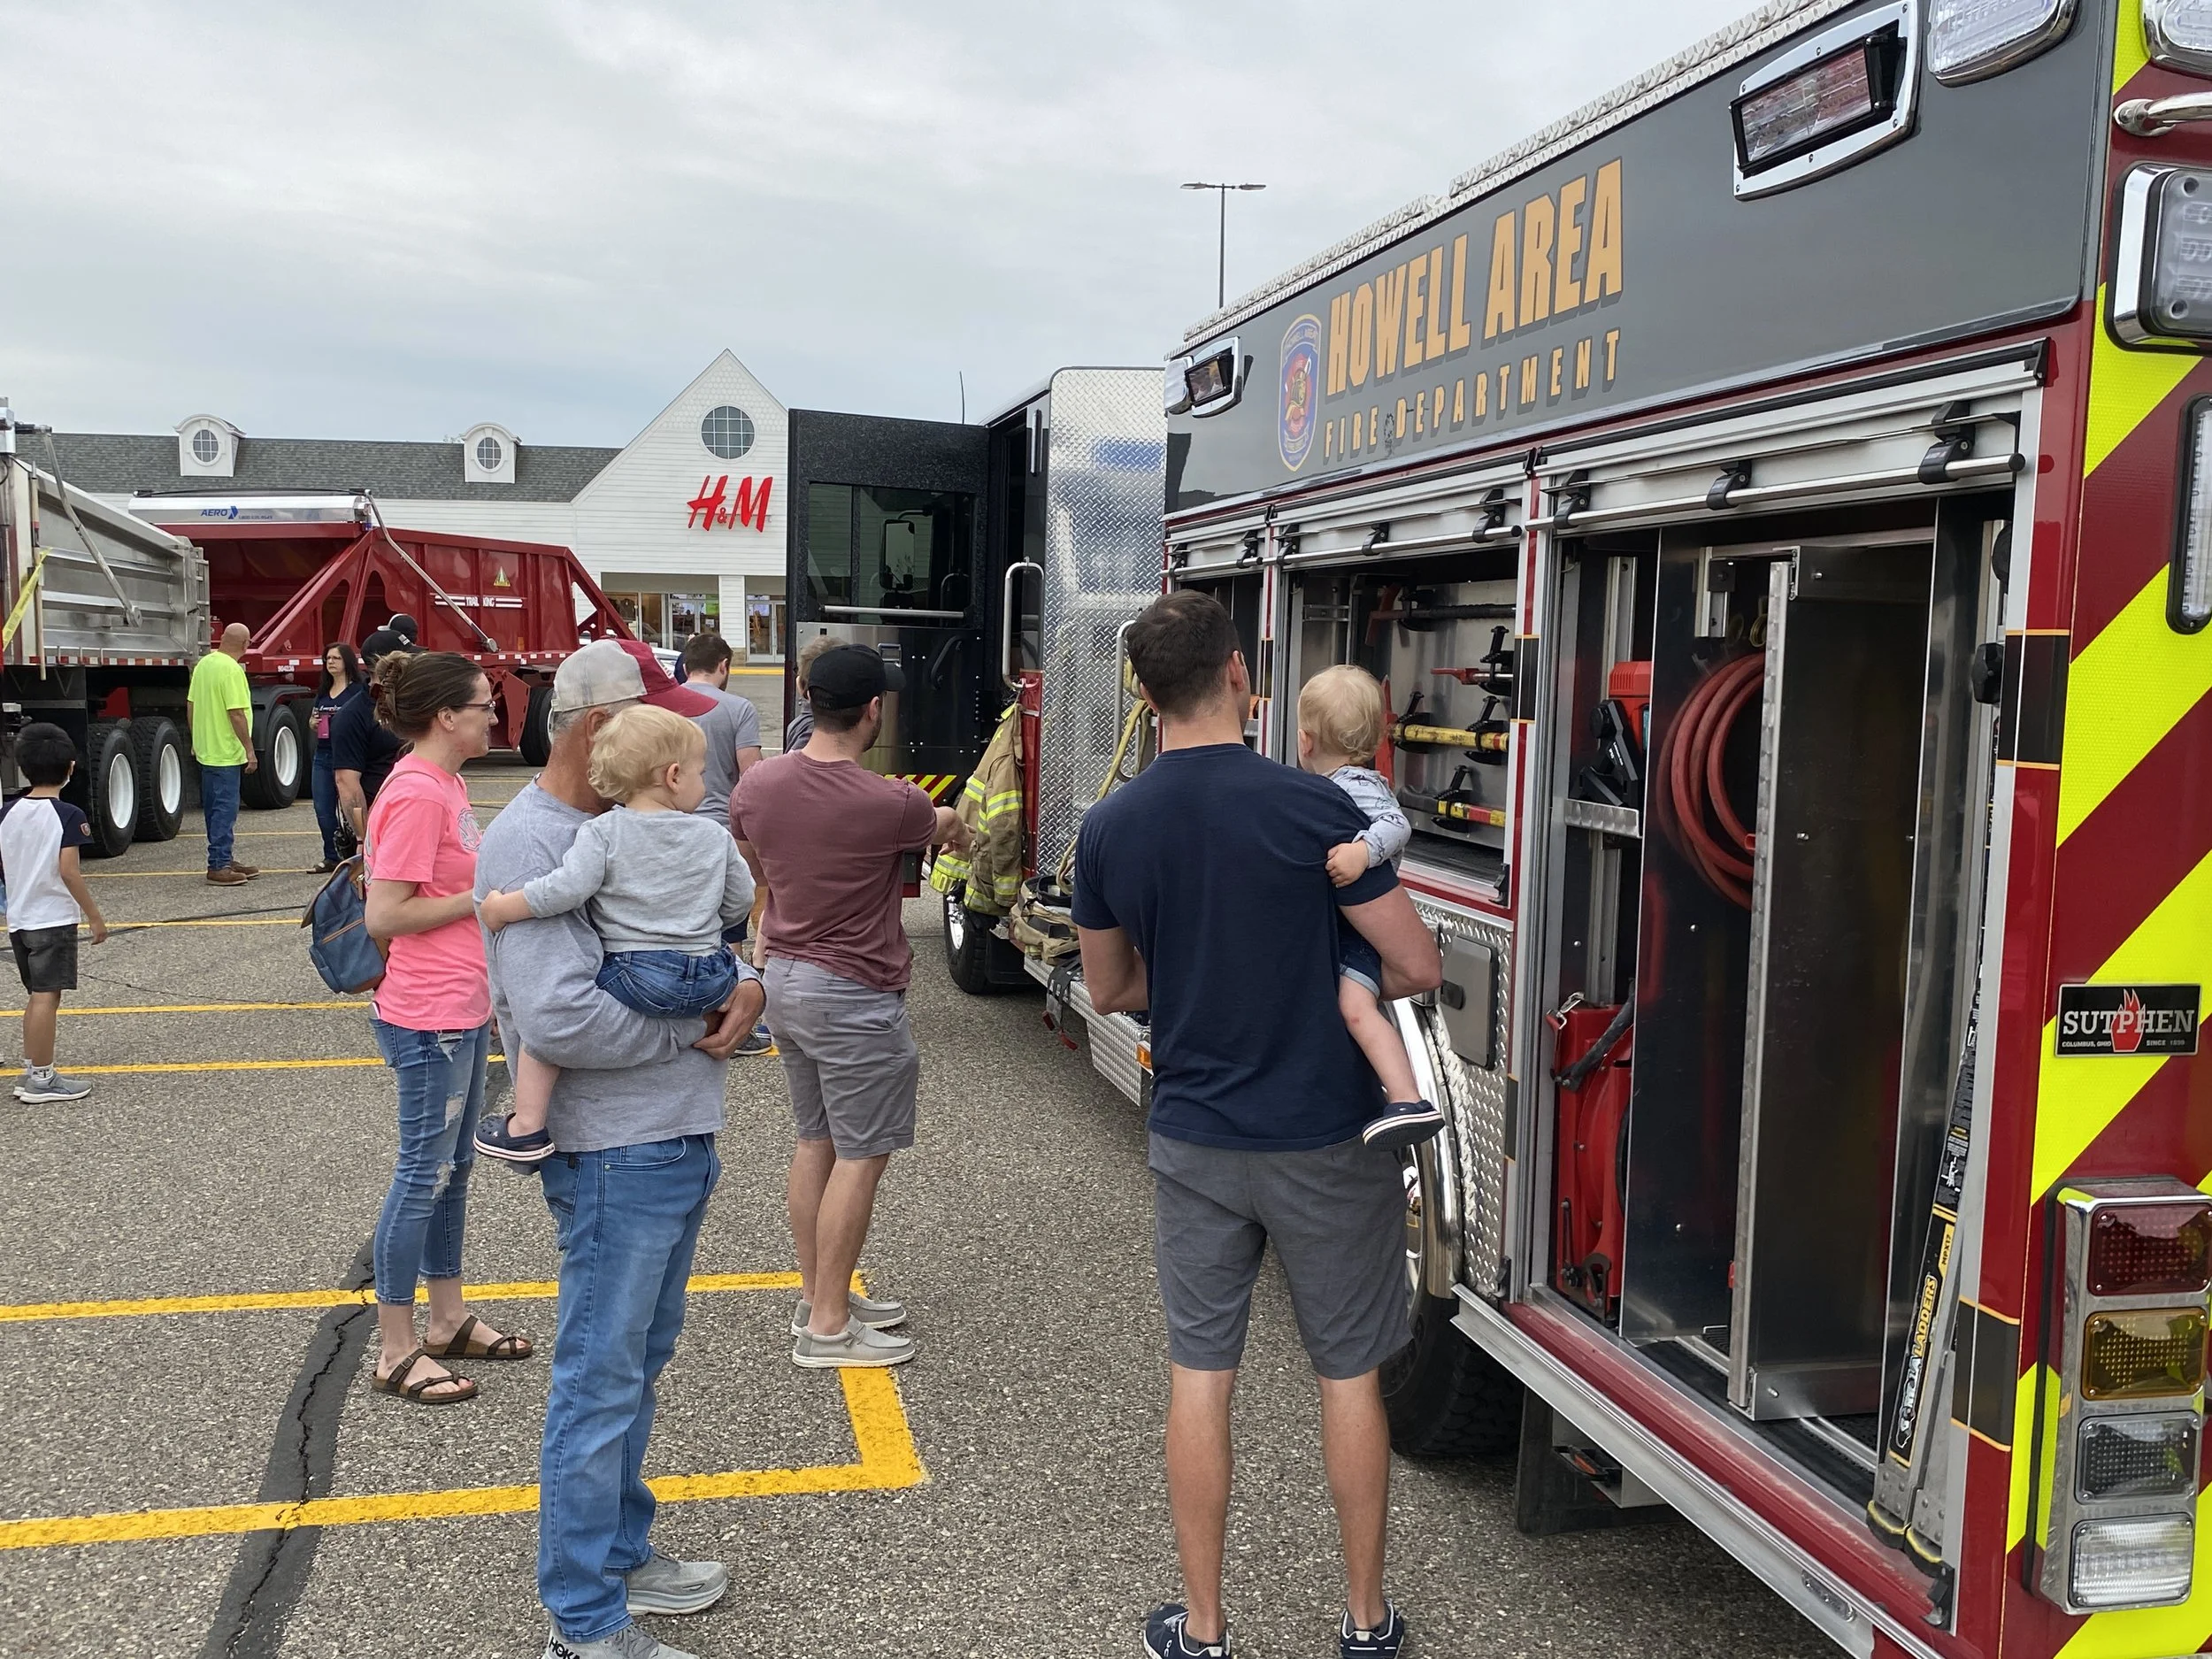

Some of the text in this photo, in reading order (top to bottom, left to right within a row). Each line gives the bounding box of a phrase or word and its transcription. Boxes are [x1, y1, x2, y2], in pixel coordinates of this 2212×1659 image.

[1325, 157, 1624, 398] HOWELL AREA
[1325, 328, 1620, 458] FIRE DEPARTMENT
[687, 474, 773, 533] H&M
[2062, 1010, 2195, 1034] SUTPHEN
[1941, 1233, 1952, 1265] MPX17
[1912, 1275, 1938, 1358] LADDERS
